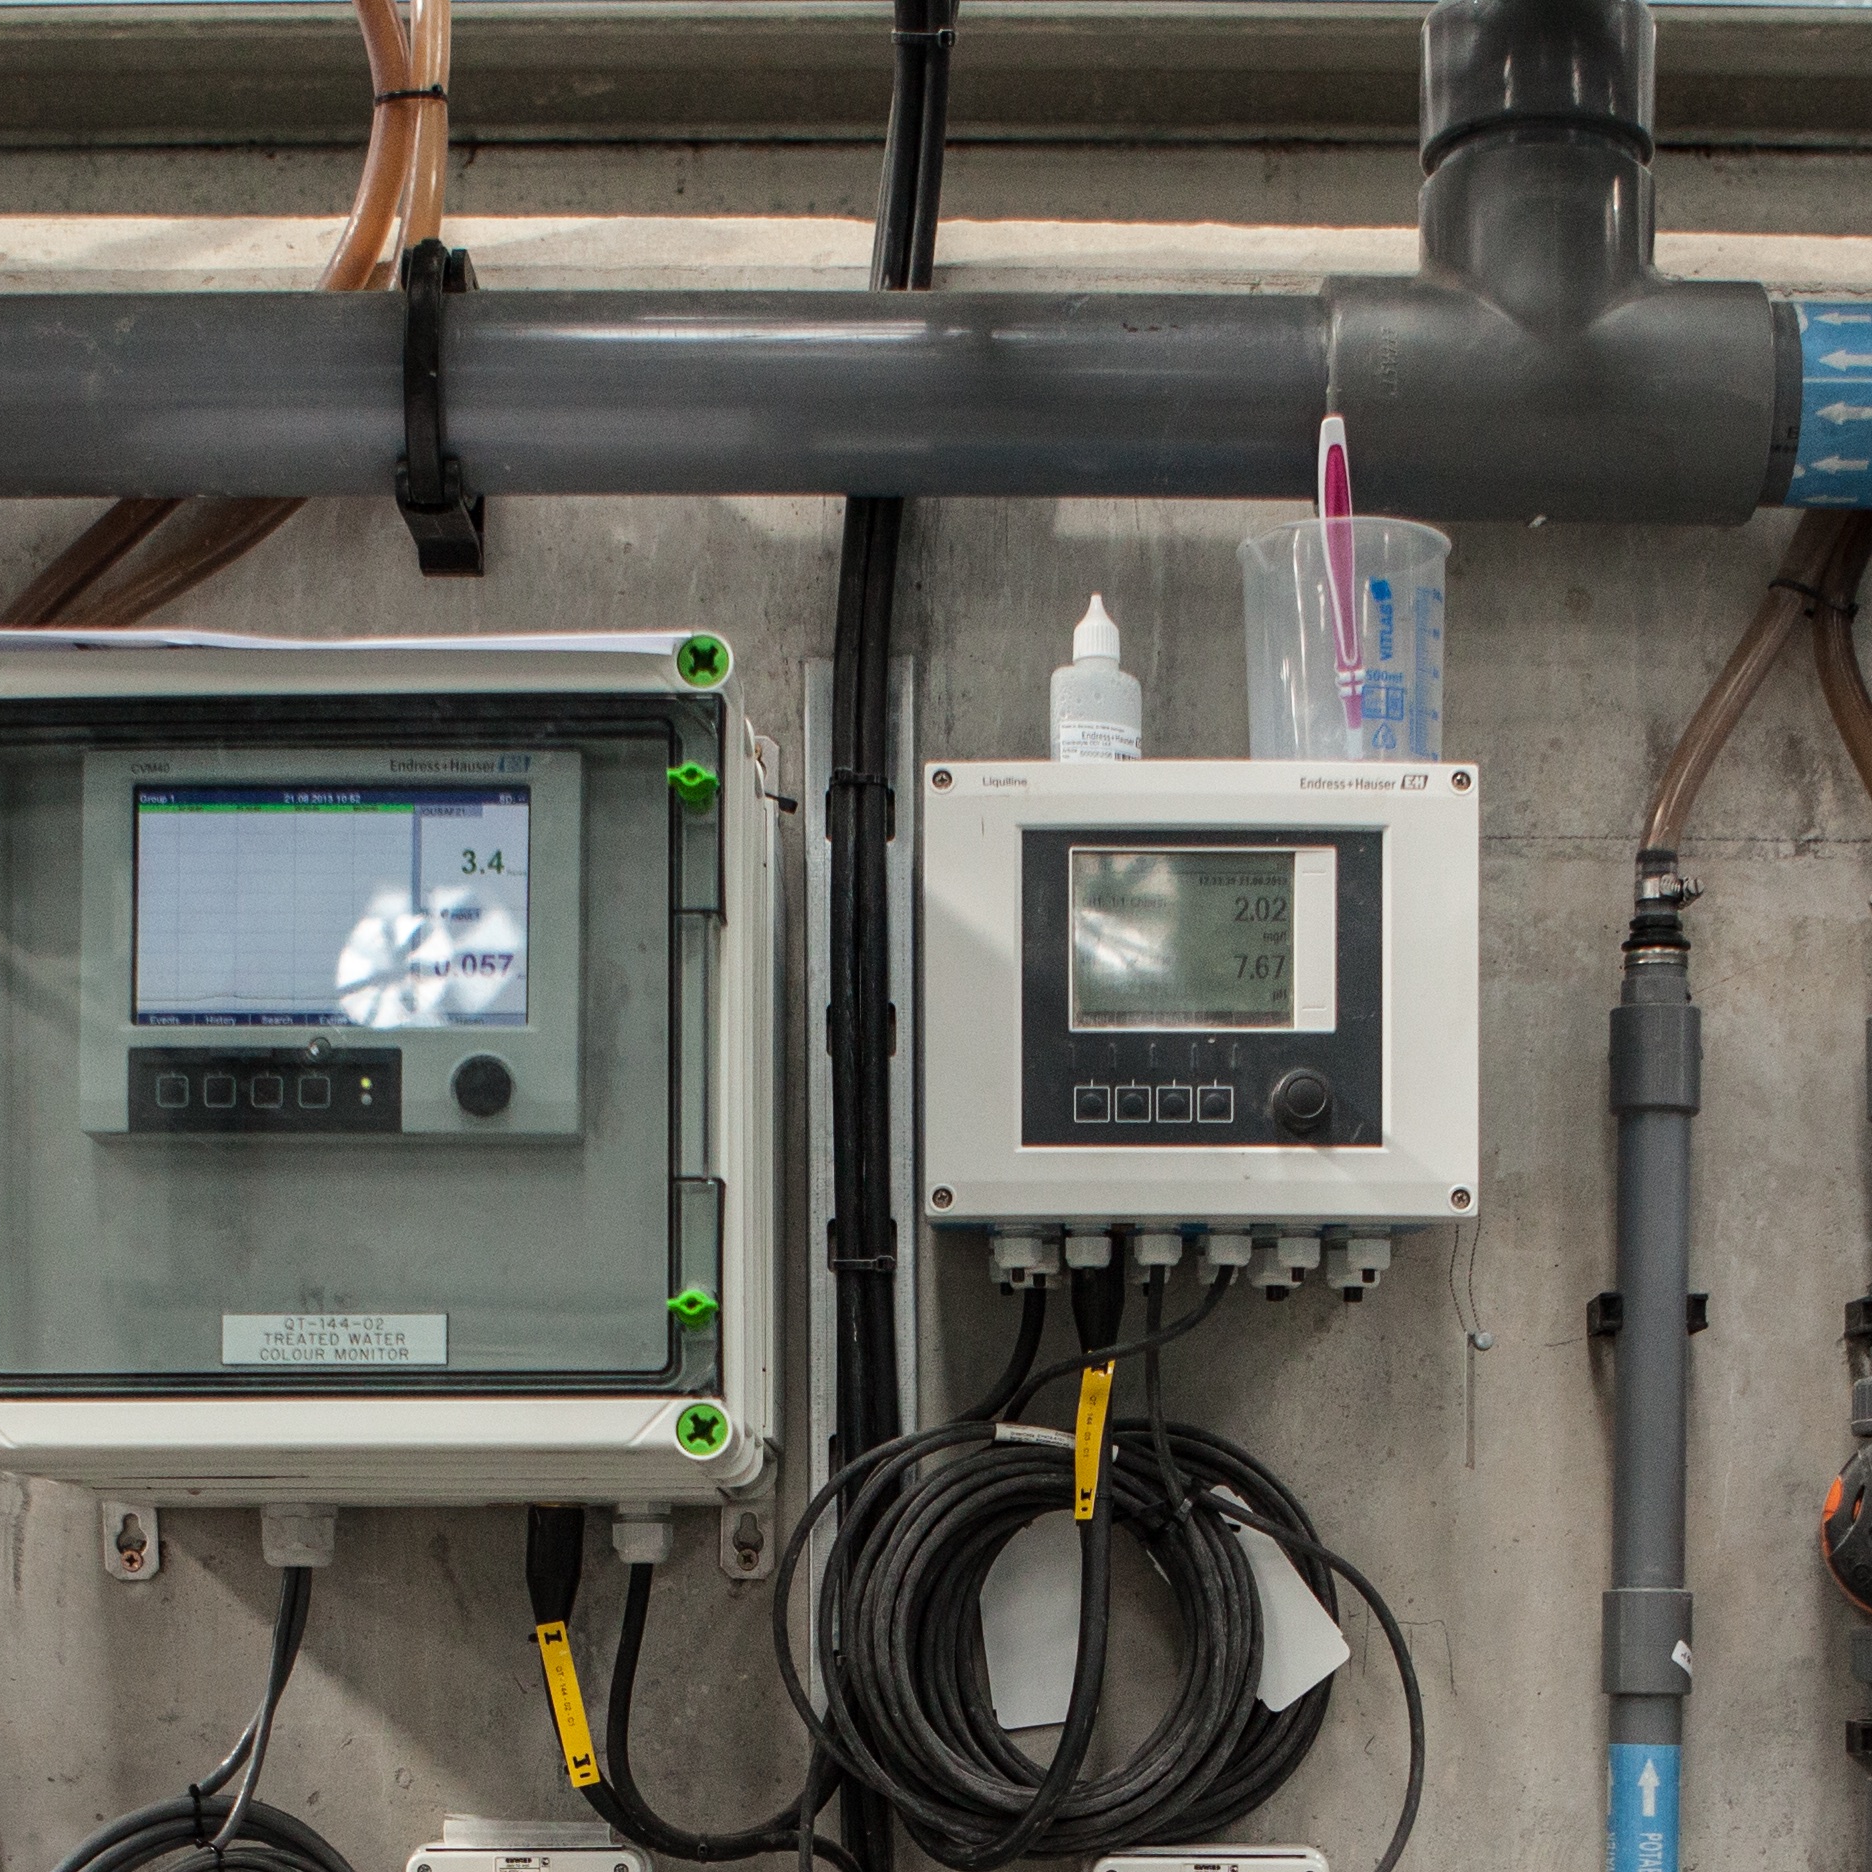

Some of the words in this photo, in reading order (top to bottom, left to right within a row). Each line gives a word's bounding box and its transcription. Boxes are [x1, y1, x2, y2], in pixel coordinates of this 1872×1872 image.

[1299, 776, 1396, 791] Endress+Hauser
[461, 849, 504, 875] 3.4
[1233, 896, 1287, 922] 2.02
[1233, 954, 1286, 980] 7.67
[284, 1316, 385, 1331] QT-144-02
[264, 1333, 339, 1346] TREATED
[348, 1333, 406, 1346] WATER
[260, 1348, 325, 1361] COLOUR
[334, 1349, 409, 1361] MONITOR
